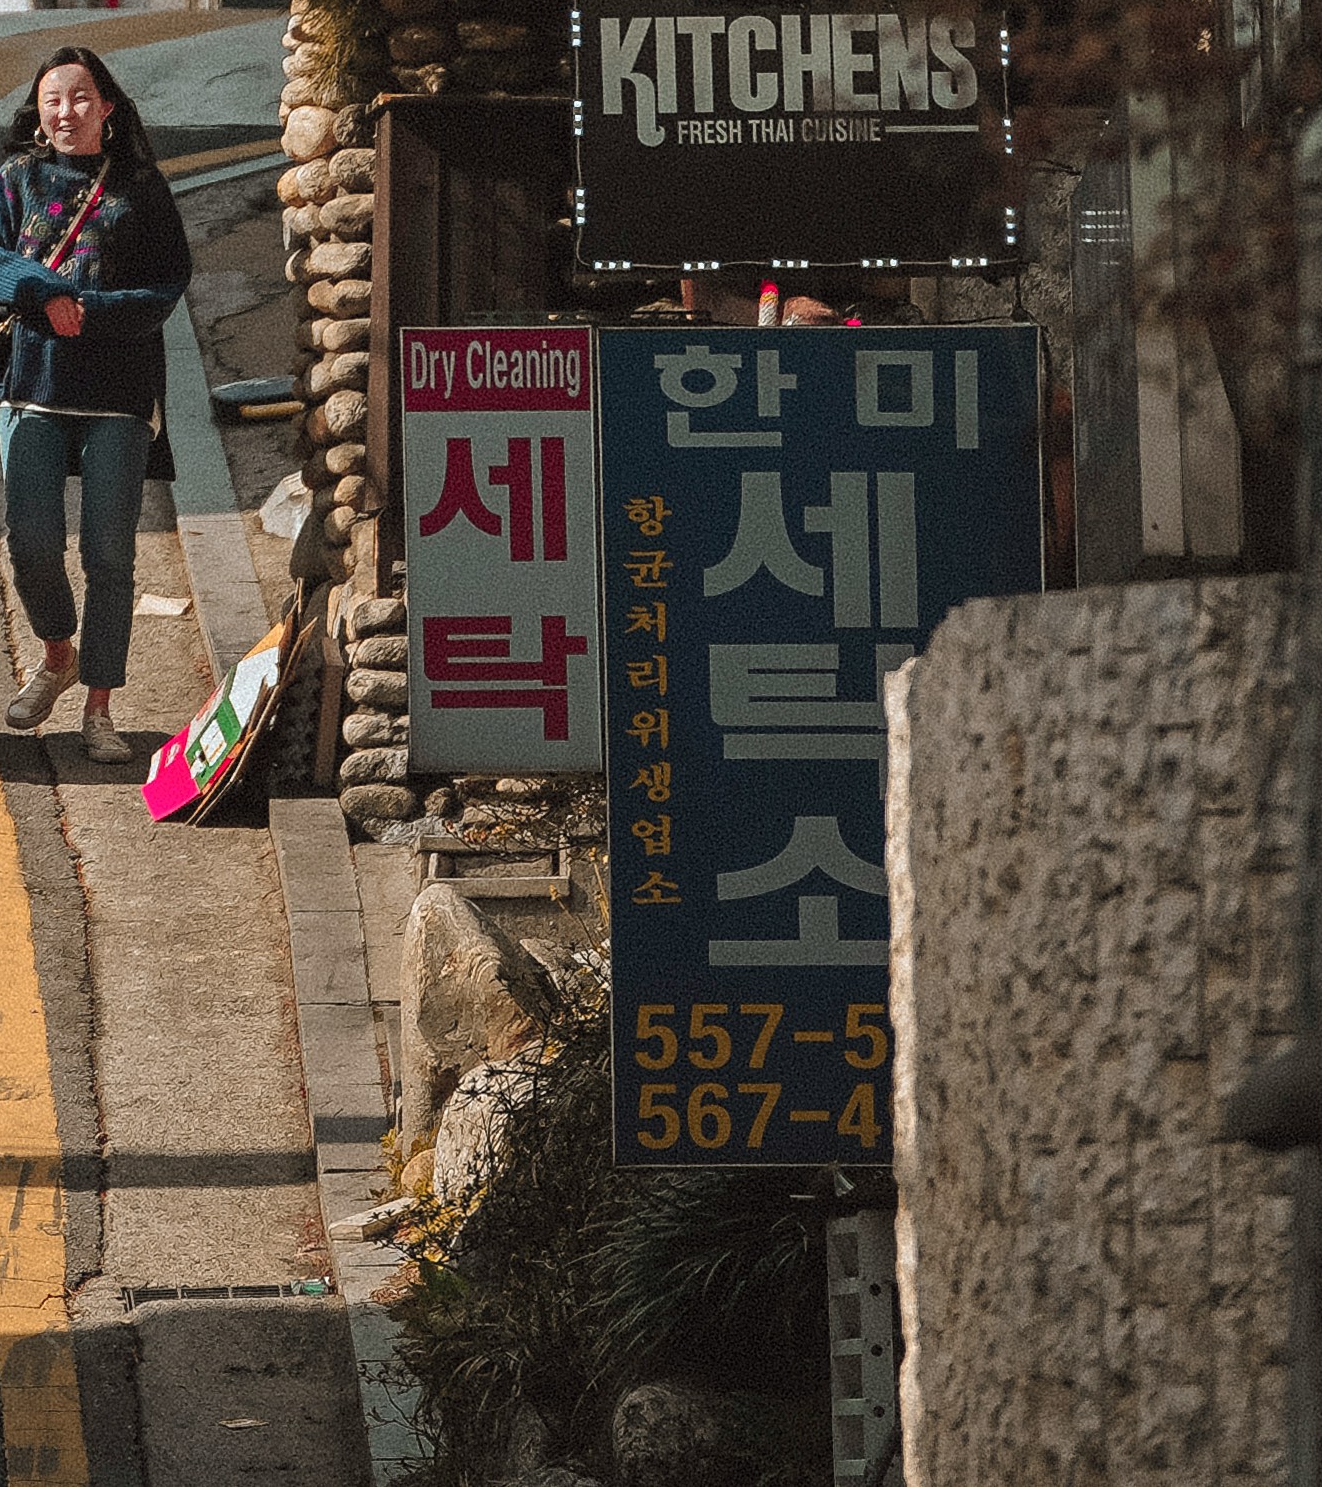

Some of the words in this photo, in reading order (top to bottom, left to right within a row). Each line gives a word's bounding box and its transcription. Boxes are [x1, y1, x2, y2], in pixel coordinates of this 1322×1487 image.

[600, 13, 979, 147] KITCHENS
[677, 119, 743, 145] FRESH
[748, 119, 794, 143] THAI
[801, 117, 881, 143] CUISINE
[410, 341, 456, 399] Dry
[466, 340, 581, 397] Cleaning
[419, 437, 589, 741] 세탁
